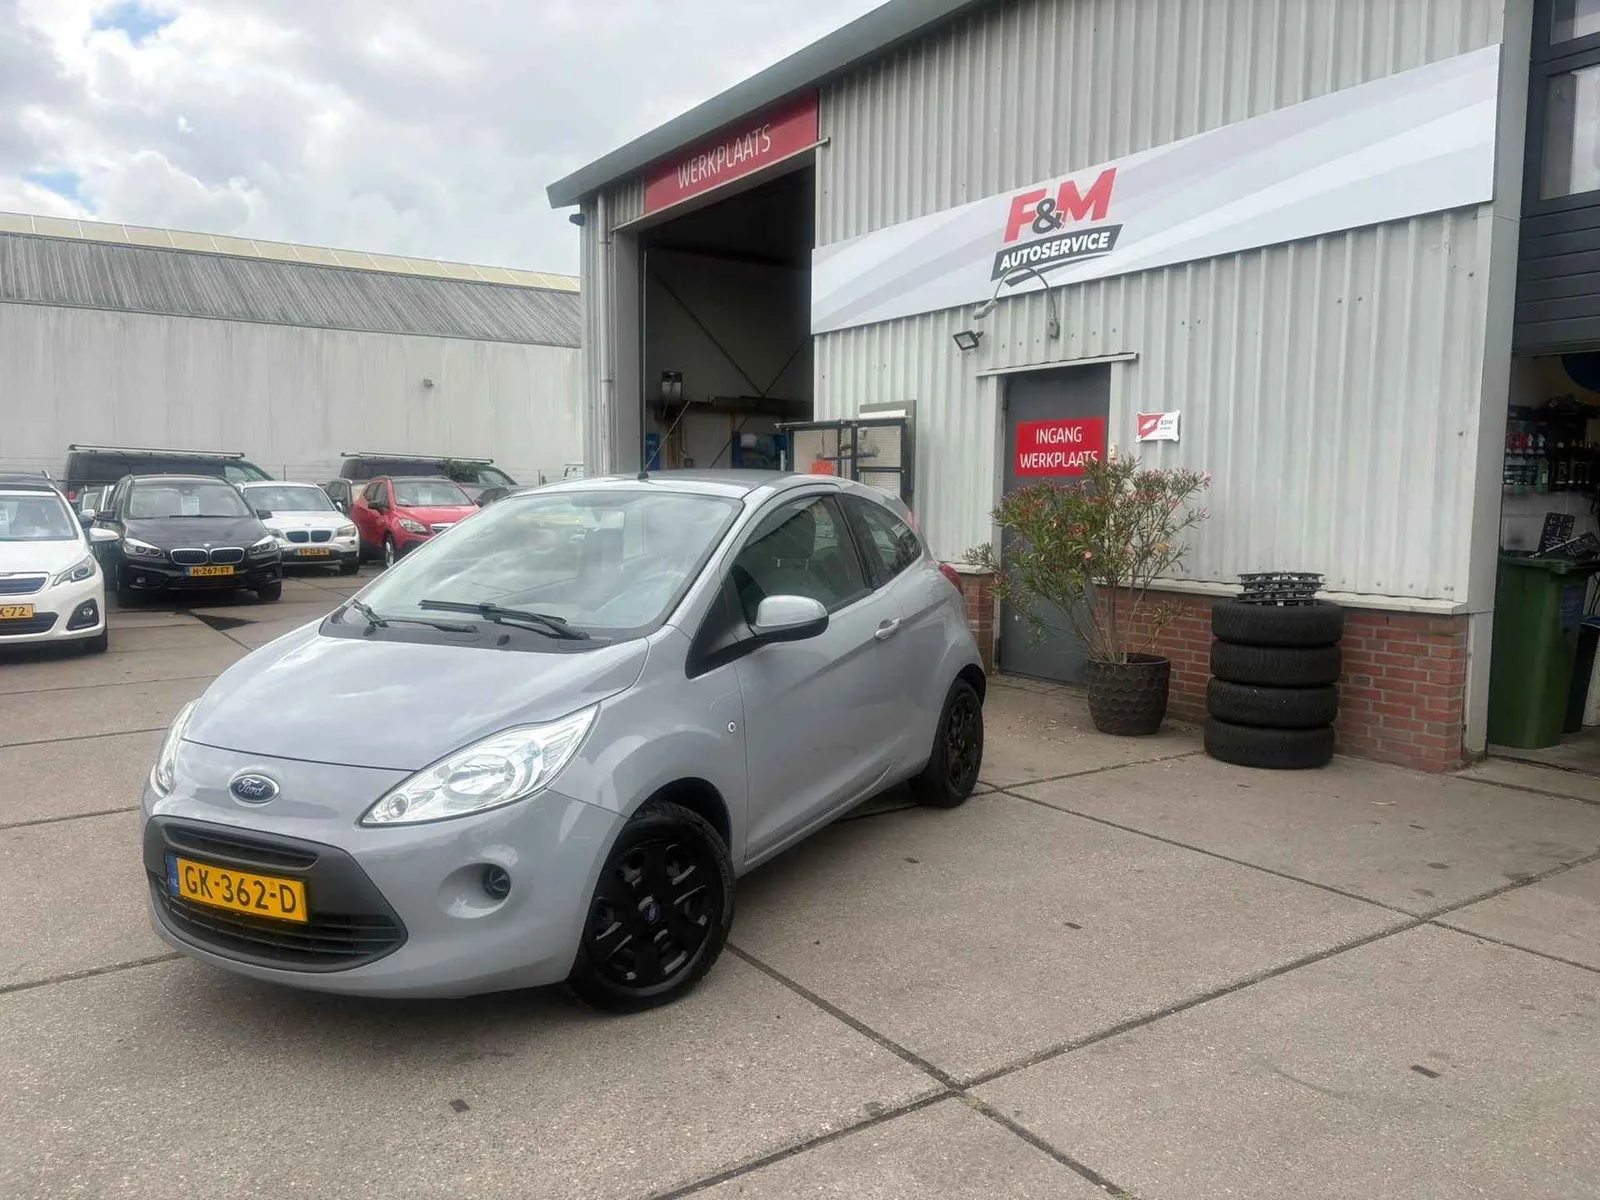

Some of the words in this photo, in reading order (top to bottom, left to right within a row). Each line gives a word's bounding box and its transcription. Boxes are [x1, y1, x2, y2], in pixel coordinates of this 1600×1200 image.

[677, 123, 771, 189] WERKPLAATS
[1003, 167, 1117, 244] F&M
[999, 231, 1111, 271] AUTOSERVICE
[1035, 426, 1082, 444] INGANG
[1020, 450, 1099, 468] WERKPLAATS
[238, 777, 266, 797] Ford
[184, 865, 297, 914] GK-362-D
